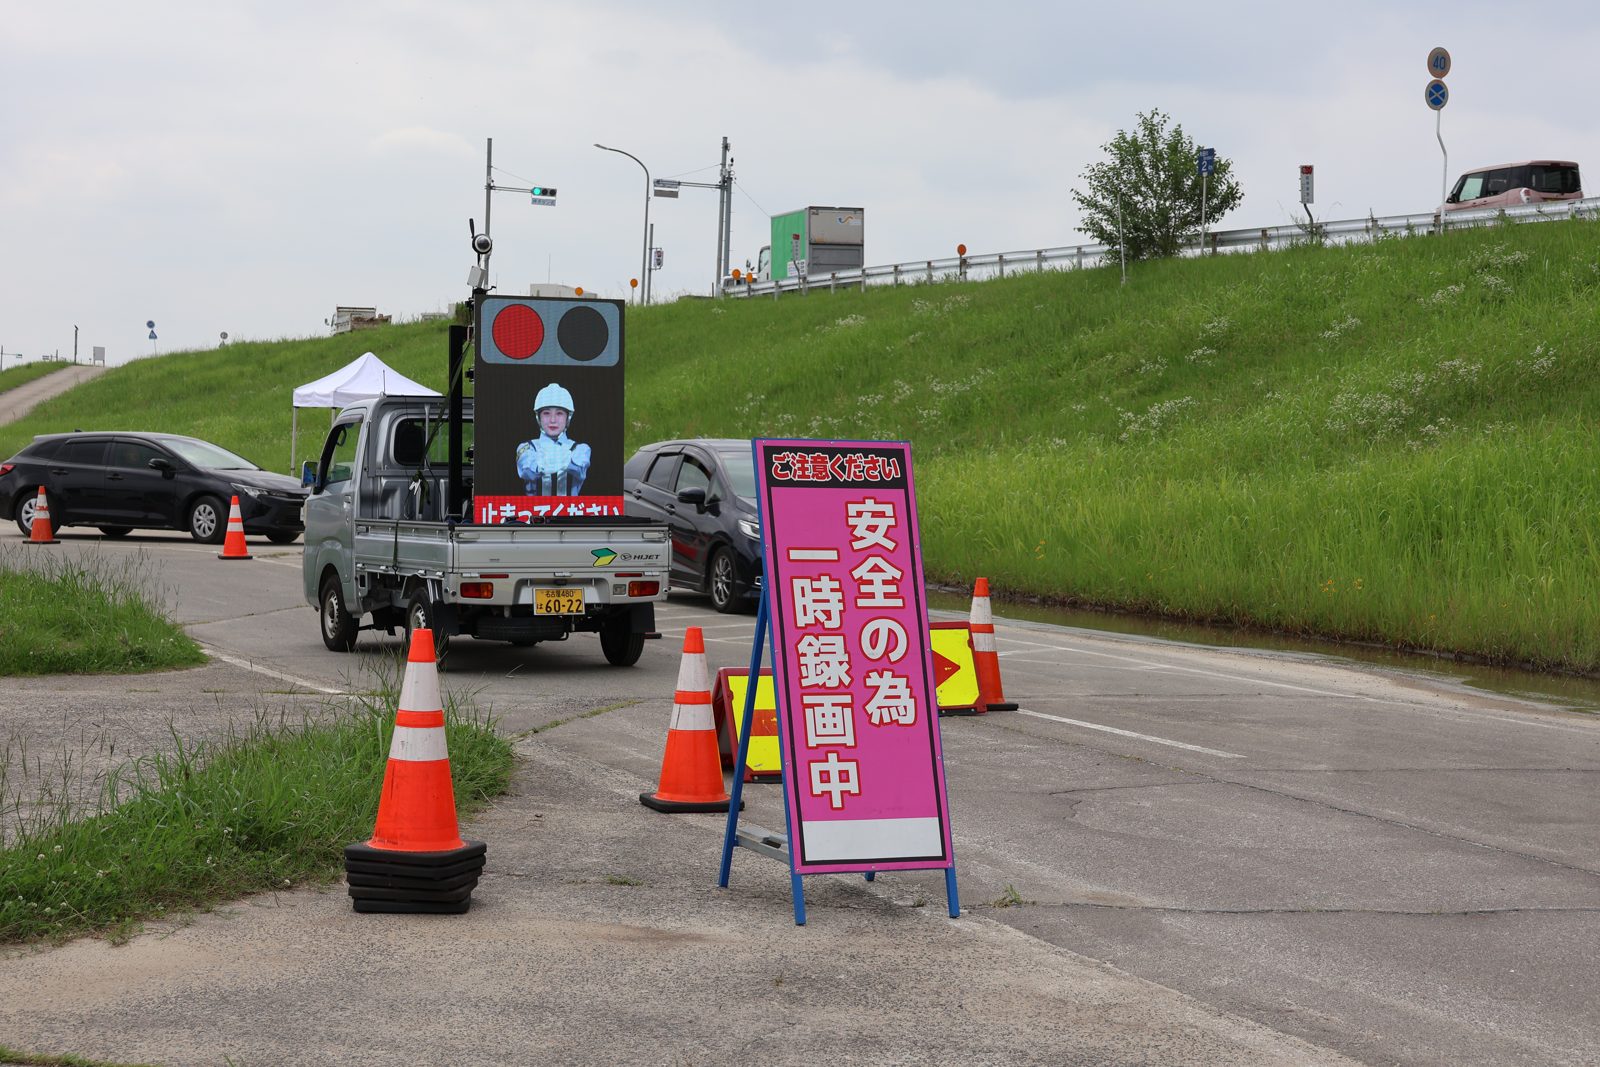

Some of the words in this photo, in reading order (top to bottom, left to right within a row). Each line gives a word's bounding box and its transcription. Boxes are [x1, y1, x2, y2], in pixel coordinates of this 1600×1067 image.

[1433, 55, 1446, 70] 40
[772, 451, 901, 481] ご注意ください
[545, 599, 583, 613] 60-22
[846, 497, 917, 727] 安全の為
[787, 546, 861, 810] 一時録画中
